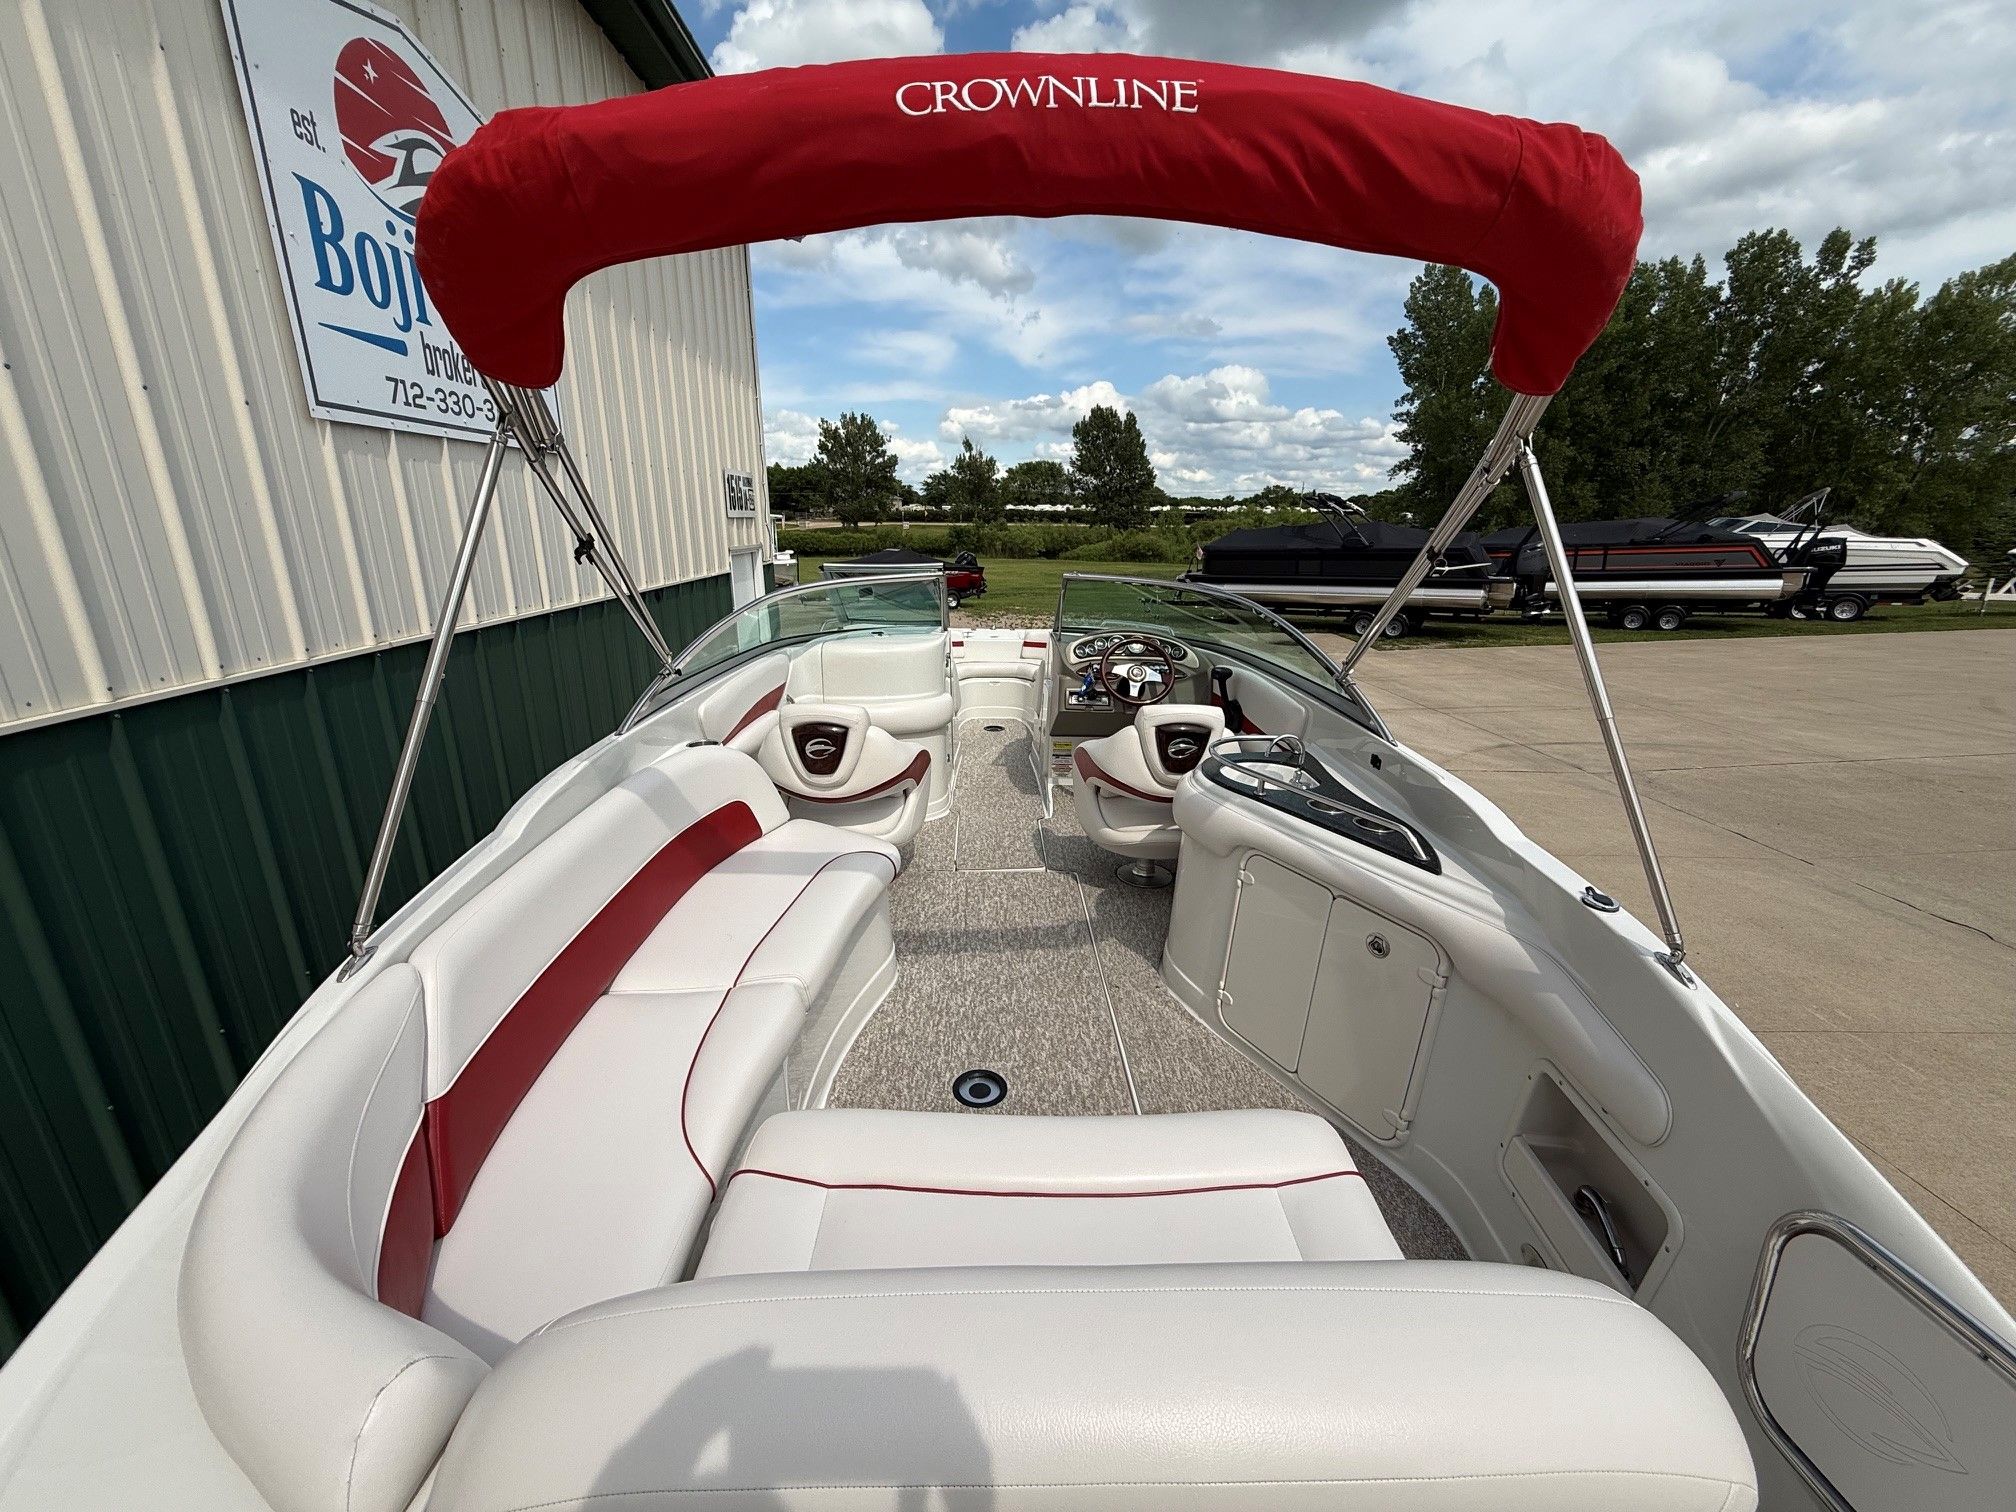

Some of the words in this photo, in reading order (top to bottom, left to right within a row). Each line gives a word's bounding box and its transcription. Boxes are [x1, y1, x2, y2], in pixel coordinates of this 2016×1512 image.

[896, 75, 1198, 115] CROWNLINE
[290, 107, 326, 153] est.
[420, 331, 489, 390] broker
[385, 375, 495, 423] 712-330-3
